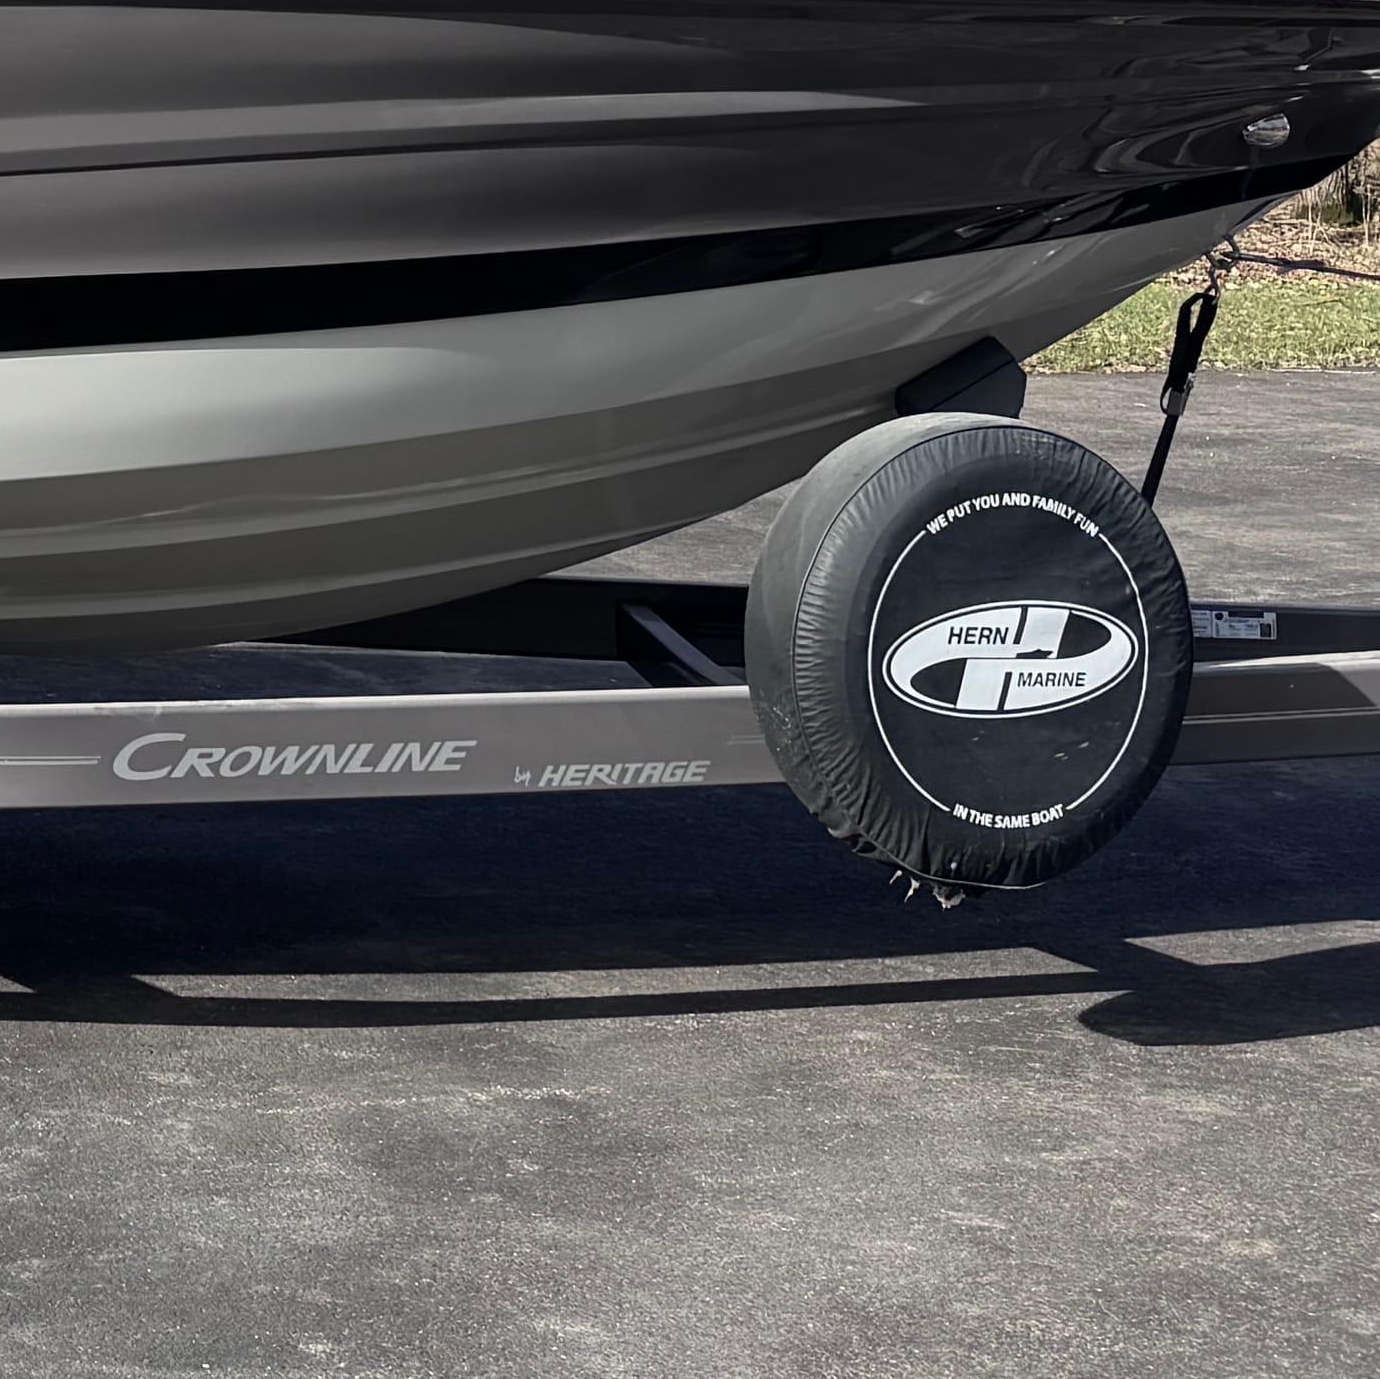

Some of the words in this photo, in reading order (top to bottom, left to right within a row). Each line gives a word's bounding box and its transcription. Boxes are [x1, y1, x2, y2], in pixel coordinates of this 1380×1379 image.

[926, 514, 948, 534] WE
[947, 500, 971, 523] PUT
[972, 493, 1000, 511] YOU
[1001, 492, 1031, 507] AND
[1032, 494, 1074, 520] FAMILY
[1073, 513, 1100, 537] FUN
[947, 626, 1009, 645] HERN
[1017, 672, 1087, 688] MARINE
[112, 733, 477, 781] CROWNLINE
[539, 760, 711, 788] HERITAGE
[953, 803, 969, 820] IN
[968, 809, 994, 827] THE
[994, 814, 1031, 829] SAME
[1031, 803, 1064, 826] BOAT
